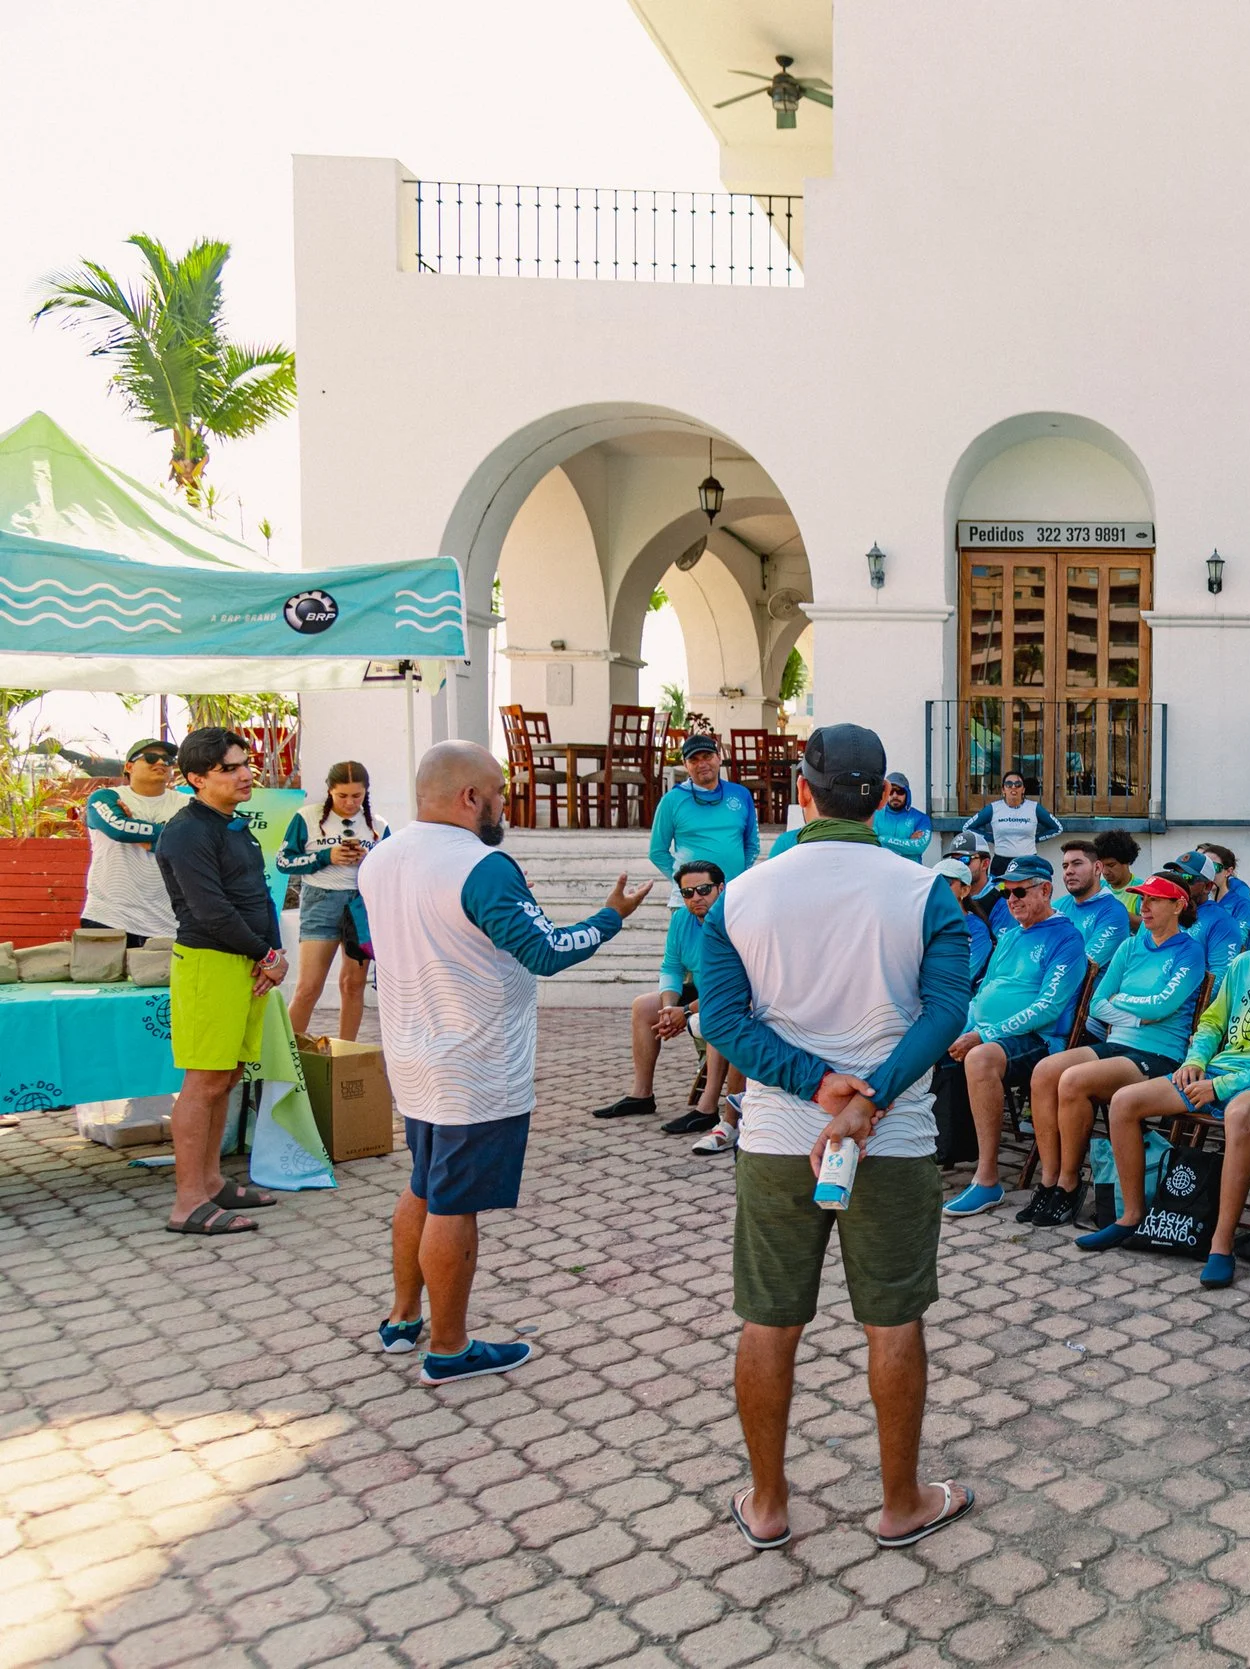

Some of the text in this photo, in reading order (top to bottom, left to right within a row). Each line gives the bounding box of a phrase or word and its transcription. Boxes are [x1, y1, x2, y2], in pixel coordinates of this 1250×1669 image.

[969, 526, 1126, 542] Pedidos 322 373 9891
[305, 613, 336, 621] BRP
[1160, 966, 1190, 1000] LLAMA
[142, 1015, 172, 1040] SOCIA
[1001, 1008, 1037, 1034] AGUA
[1165, 1177, 1196, 1197] SOCIAL CLUB
[1135, 1224, 1197, 1246] LAMANDO
